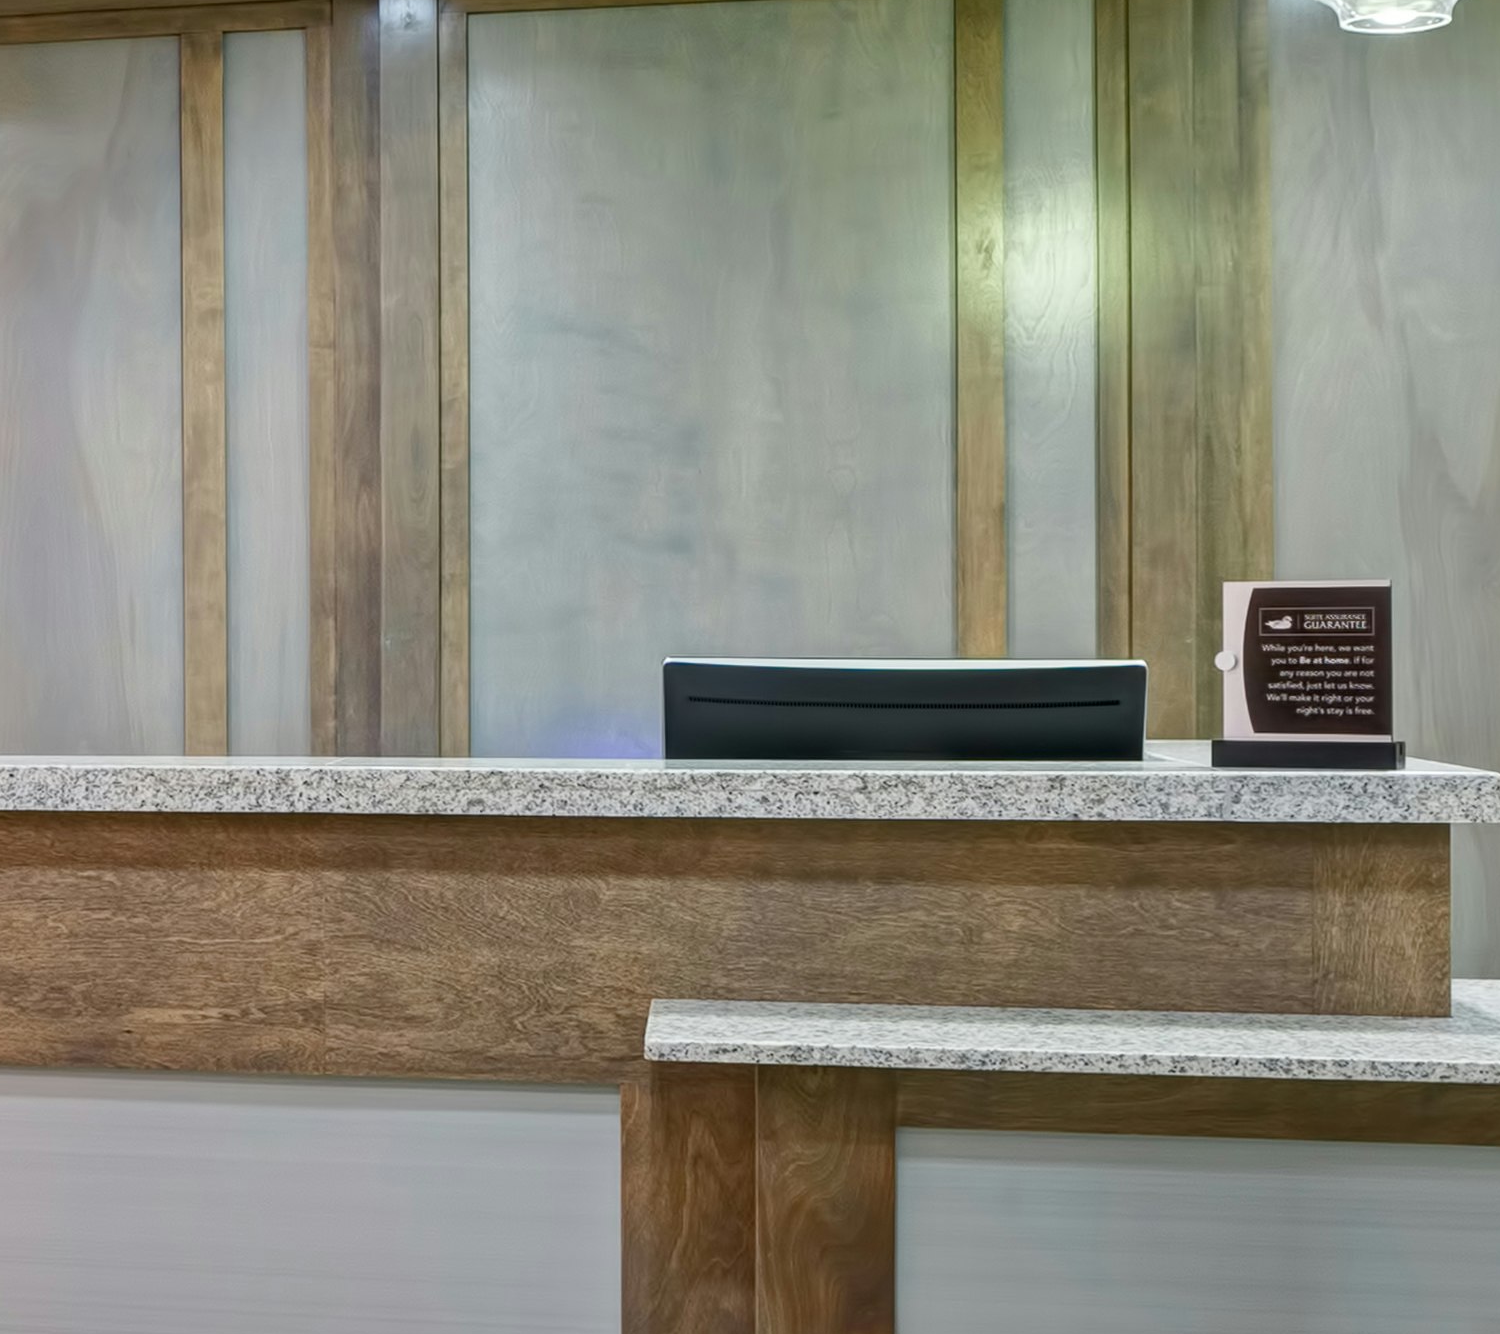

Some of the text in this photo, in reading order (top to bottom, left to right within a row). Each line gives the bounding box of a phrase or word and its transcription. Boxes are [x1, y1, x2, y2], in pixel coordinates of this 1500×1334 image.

[1303, 620, 1368, 630] GUARANTEE
[1262, 643, 1286, 652] While
[1287, 643, 1313, 654] you're
[1353, 644, 1375, 652] want
[1271, 657, 1287, 666] you
[1288, 657, 1298, 665] to
[1299, 656, 1312, 665] Be
[1313, 657, 1323, 665] at
[1361, 656, 1375, 664] for
[1279, 670, 1295, 679] any
[1326, 670, 1342, 679] you
[1321, 693, 1342, 704] right
[1355, 695, 1375, 704] your
[1326, 708, 1345, 716] stay
